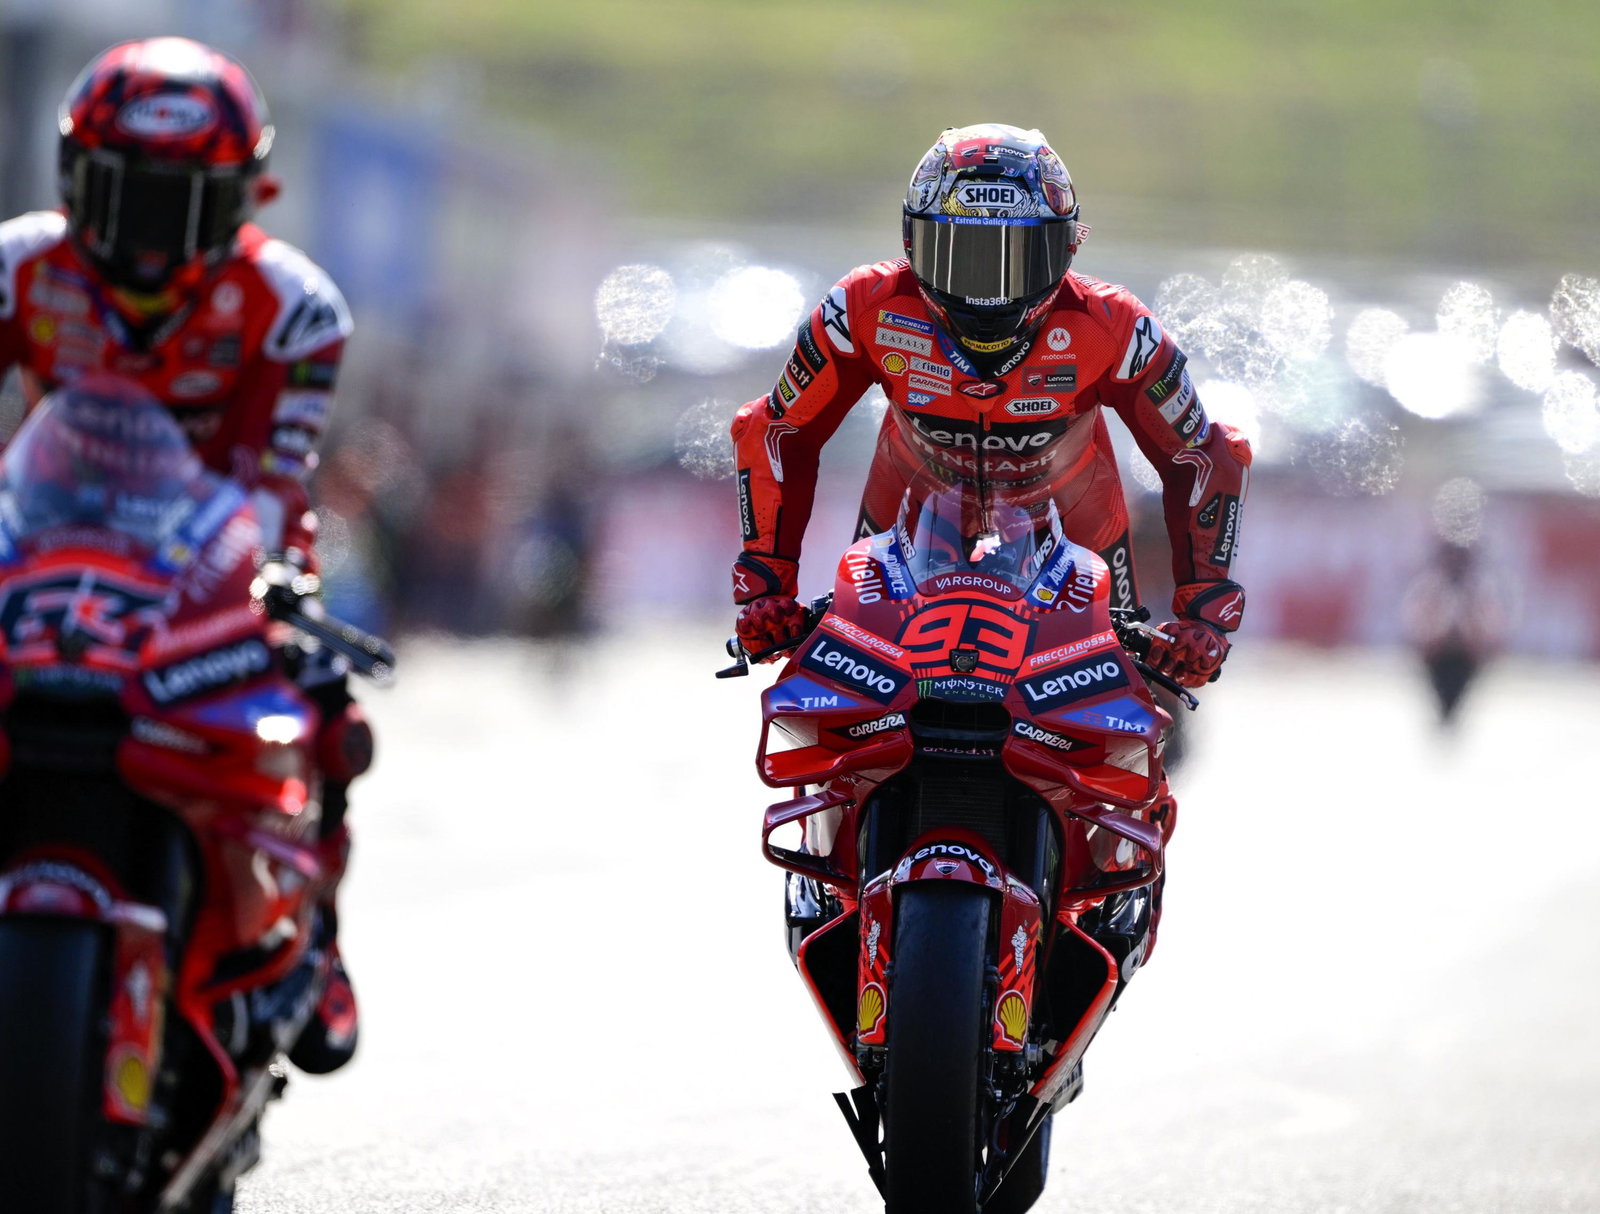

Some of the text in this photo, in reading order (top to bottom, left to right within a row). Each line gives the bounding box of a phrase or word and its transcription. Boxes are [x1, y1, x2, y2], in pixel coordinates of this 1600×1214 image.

[989, 145, 1026, 158] Lenovo
[966, 188, 1014, 204] SHOEI
[955, 217, 981, 225] Estrella
[982, 218, 1008, 226] Galicia
[965, 295, 1008, 306] Insta360
[894, 318, 930, 331] MICHELIN
[950, 350, 970, 373] TIM
[994, 341, 1030, 376] Lenovo
[922, 362, 950, 377] riello
[910, 377, 950, 391] CARRERA
[908, 392, 930, 404] SAP
[1013, 401, 1052, 412] SHOEI
[913, 417, 1053, 452] Lenovo
[740, 474, 751, 535] Lenovo
[1215, 501, 1237, 561] Lenovo
[847, 556, 882, 604] riello
[825, 617, 904, 660] FRECCIAROSSA
[900, 604, 1032, 670] 93
[1030, 633, 1115, 667] FRECCIAROSSA
[811, 641, 896, 694] Lenovo
[934, 679, 1004, 697] MONSTER
[1025, 662, 1120, 701] Lenovo
[801, 696, 838, 708] TIM
[945, 690, 994, 700] ENERGY
[849, 714, 906, 737] CARRERA
[1106, 715, 1143, 732] TIM
[1014, 722, 1073, 751] CARRERA
